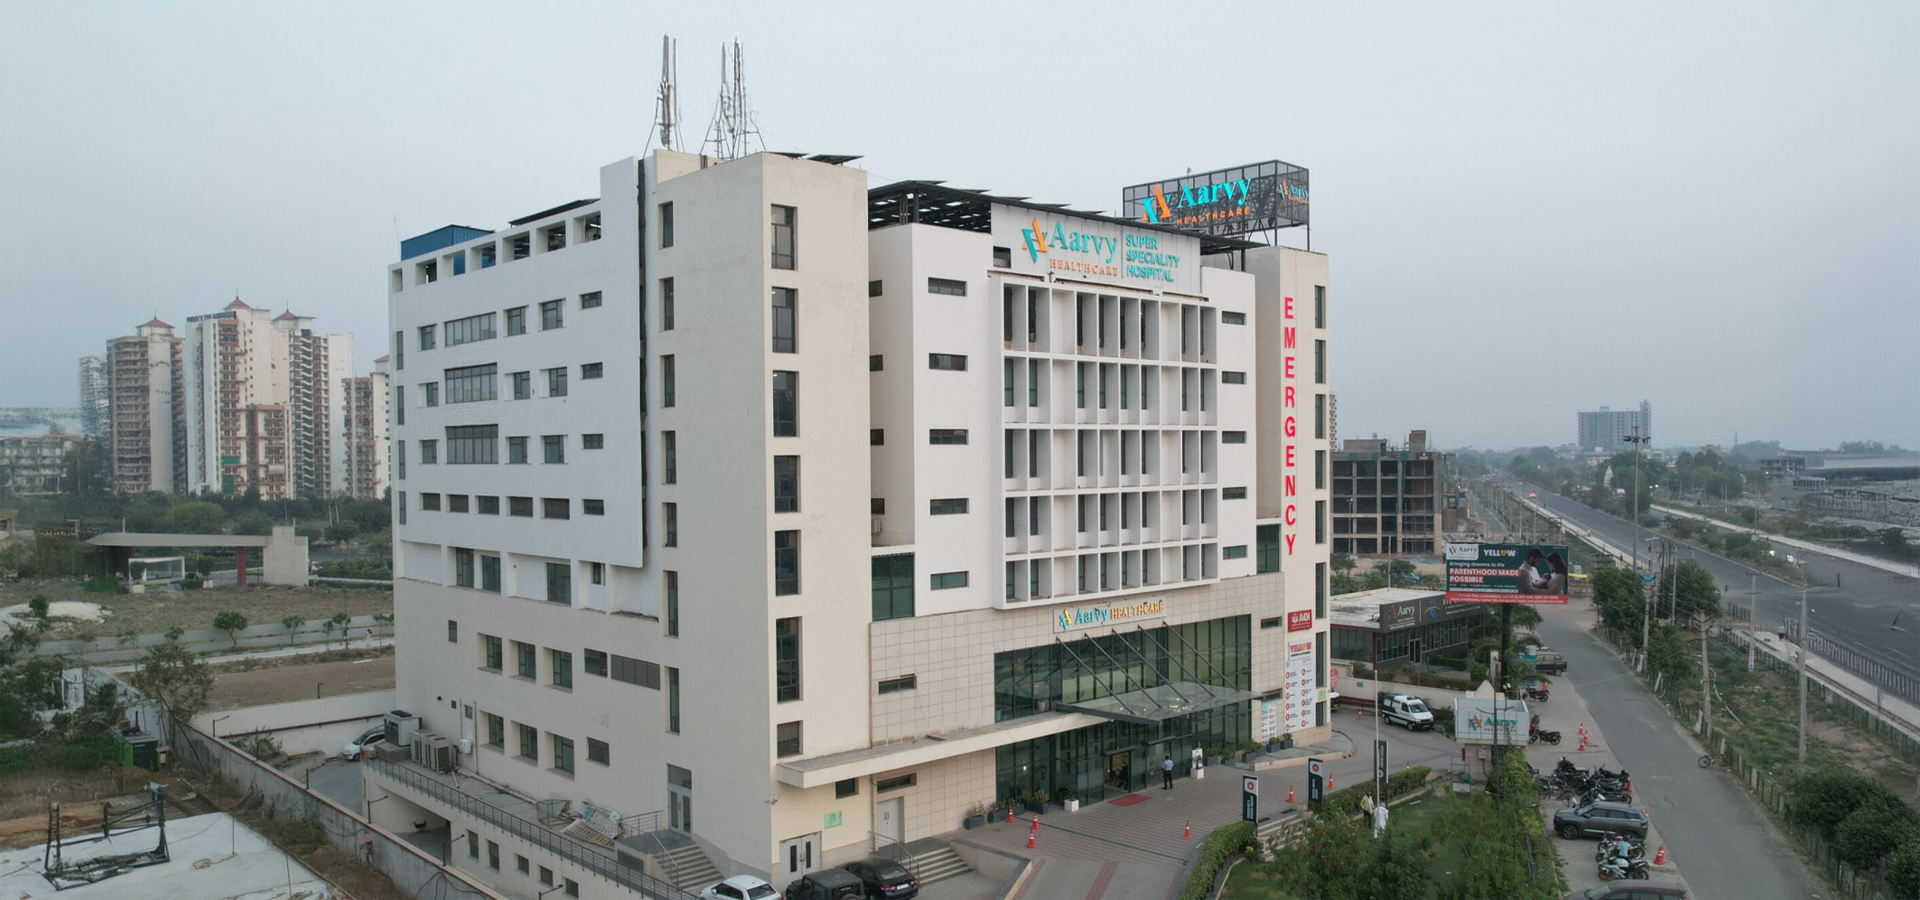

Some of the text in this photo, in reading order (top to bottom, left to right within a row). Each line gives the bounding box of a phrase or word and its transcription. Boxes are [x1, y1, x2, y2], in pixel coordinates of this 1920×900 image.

[1177, 178, 1251, 209] Aarvy
[1177, 206, 1250, 226] HEALTHCARE
[1048, 220, 1119, 263] Aarvy
[1126, 234, 1159, 250] SUPER
[1050, 258, 1118, 276] HEALTHCARE
[1126, 249, 1180, 268] SPECIALITY
[1126, 265, 1175, 282] HOSPITAL
[1284, 297, 1296, 556] EMERGENCY
[1075, 601, 1164, 624] Aarvy HEALTHCARE
[1397, 605, 1416, 616] Aarvy
